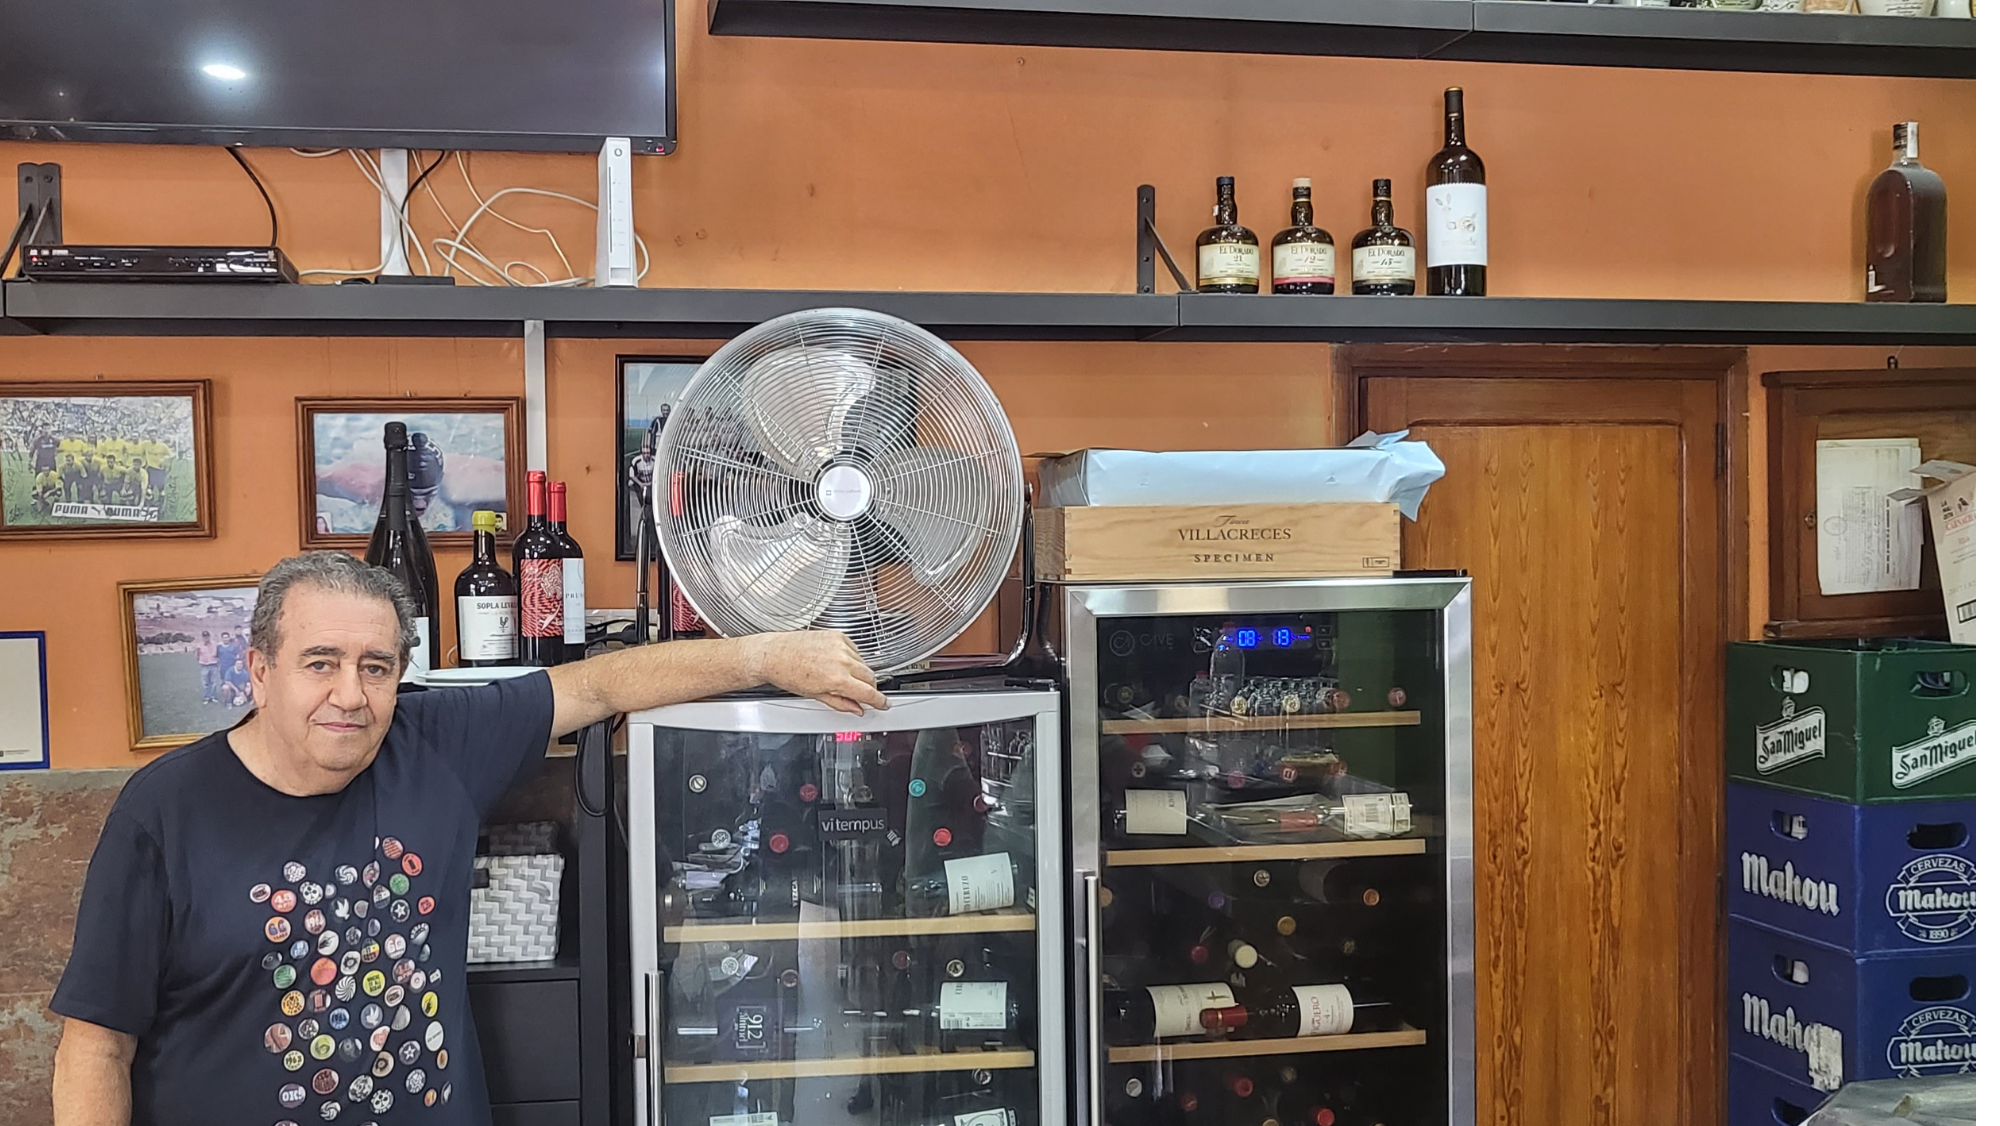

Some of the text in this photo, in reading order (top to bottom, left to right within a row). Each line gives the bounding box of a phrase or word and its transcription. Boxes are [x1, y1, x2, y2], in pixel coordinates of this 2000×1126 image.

[54, 504, 88, 515] PUMA
[1177, 528, 1292, 541] VILLACRECES
[1193, 553, 1275, 563] SPECIMEN
[476, 602, 500, 610] SOPLA
[1910, 858, 1966, 874] CERVEZAS
[1742, 852, 1840, 917] Mahou
[1911, 1011, 1968, 1027] CERVEZAS
[747, 1014, 763, 1040] 912
